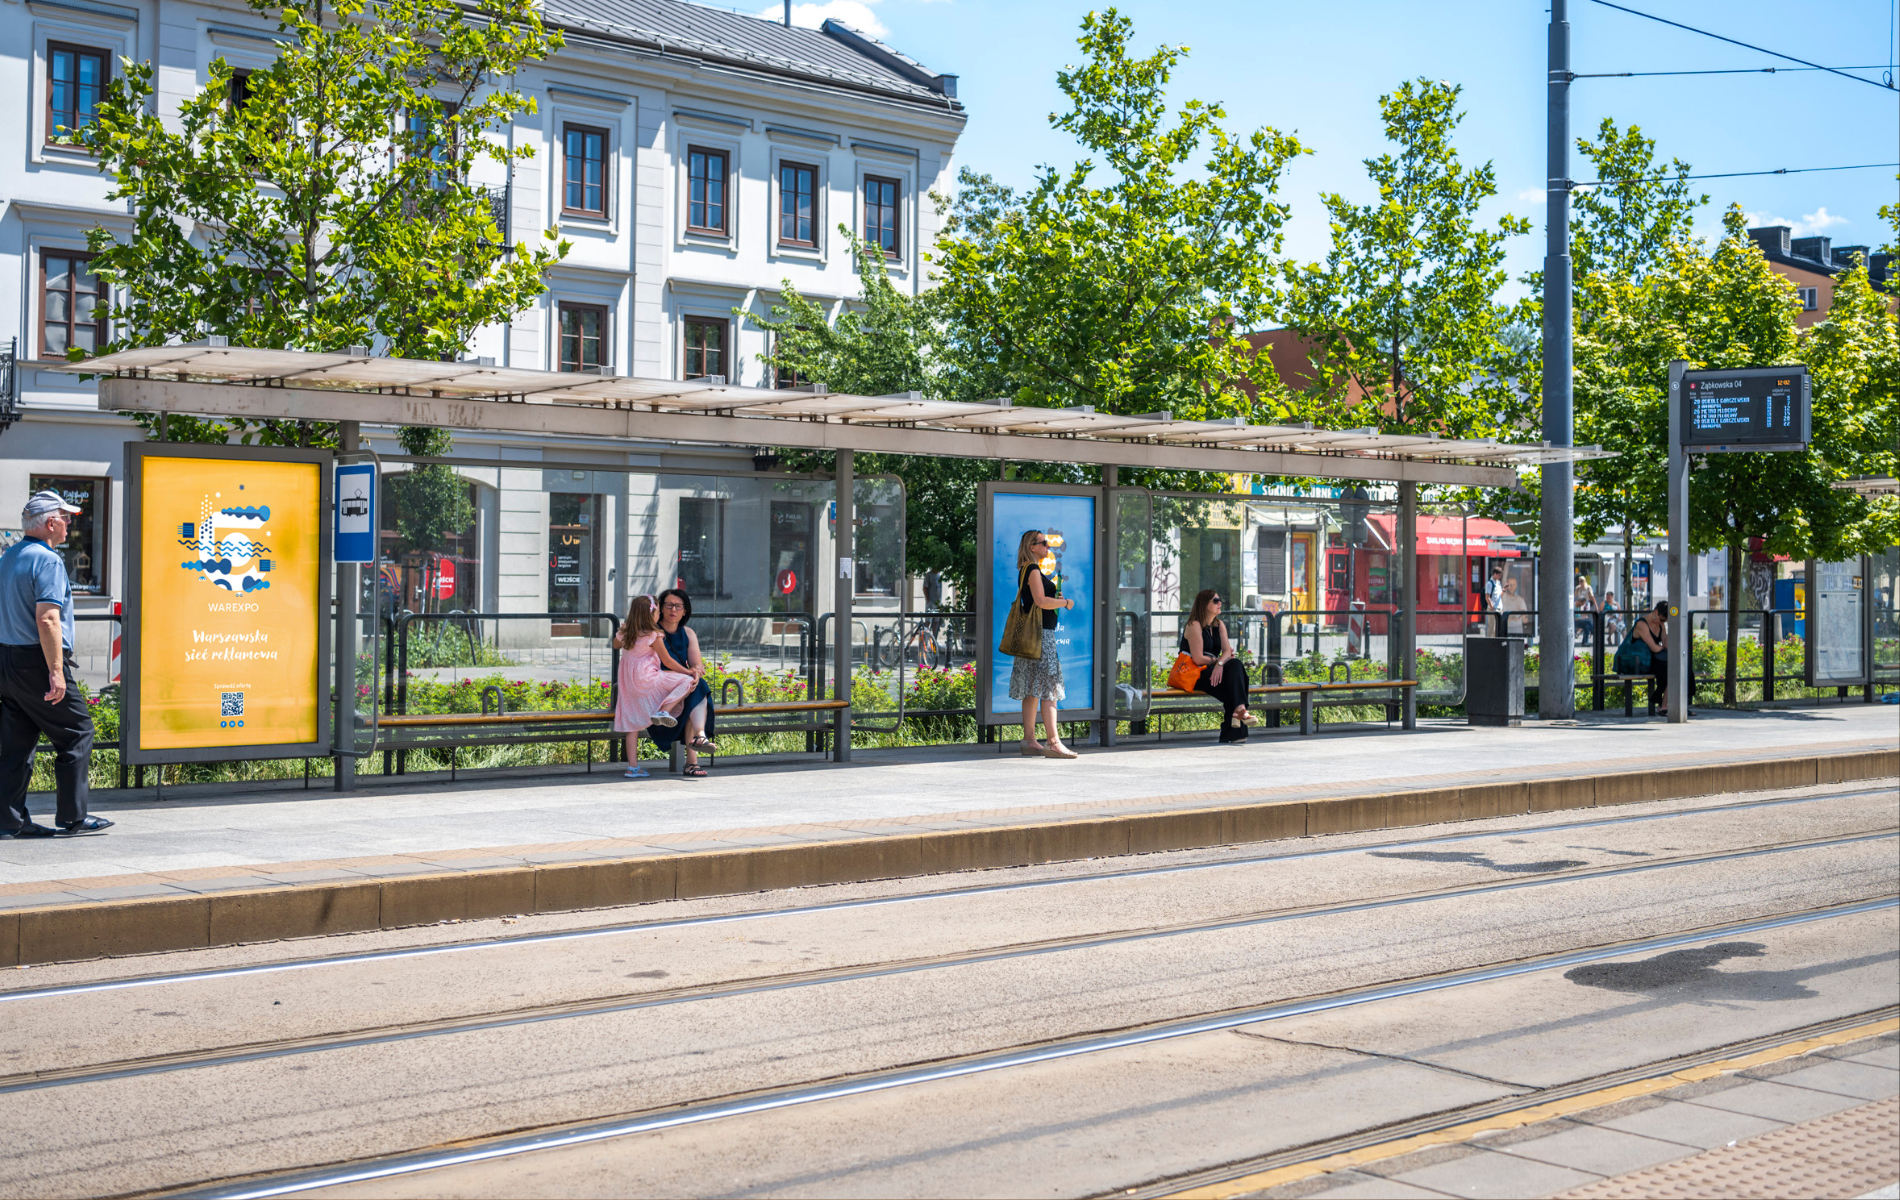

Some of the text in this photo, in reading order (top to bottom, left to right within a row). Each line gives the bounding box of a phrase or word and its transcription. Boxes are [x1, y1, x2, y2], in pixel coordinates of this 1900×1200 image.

[1700, 380, 1742, 391] Ząbkowska 04
[63, 490, 89, 499] FabLab
[208, 603, 259, 612] WAREXPO
[192, 629, 268, 644] Warszawska
[185, 646, 278, 662] sieć reklamowa
[236, 682, 252, 690] ofertę
